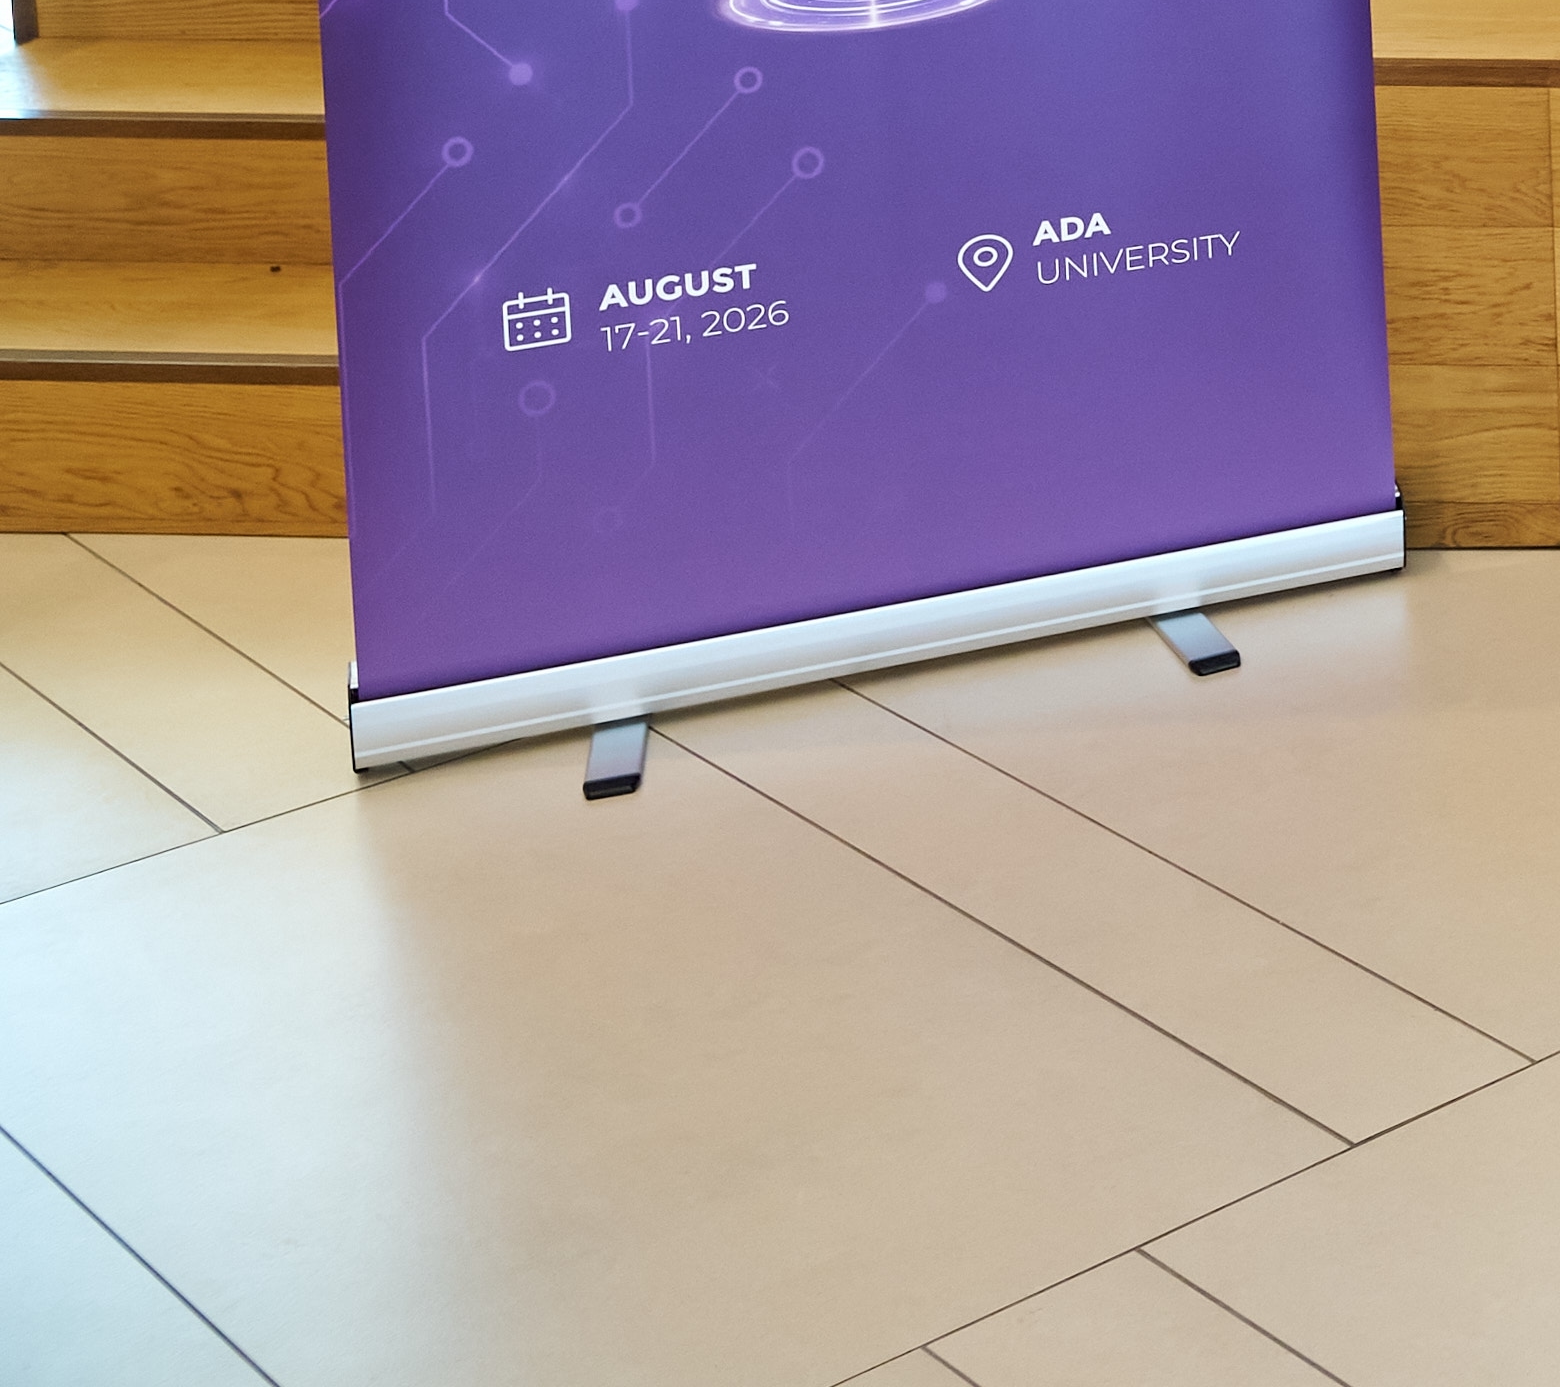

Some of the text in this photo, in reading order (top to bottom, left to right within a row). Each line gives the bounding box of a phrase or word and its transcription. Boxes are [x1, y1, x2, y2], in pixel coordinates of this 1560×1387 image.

[1032, 212, 1111, 245] ADA
[1036, 230, 1243, 285] UNIVERSITY
[598, 263, 757, 311] AUGUST
[600, 300, 790, 352] 17-21, 2026
